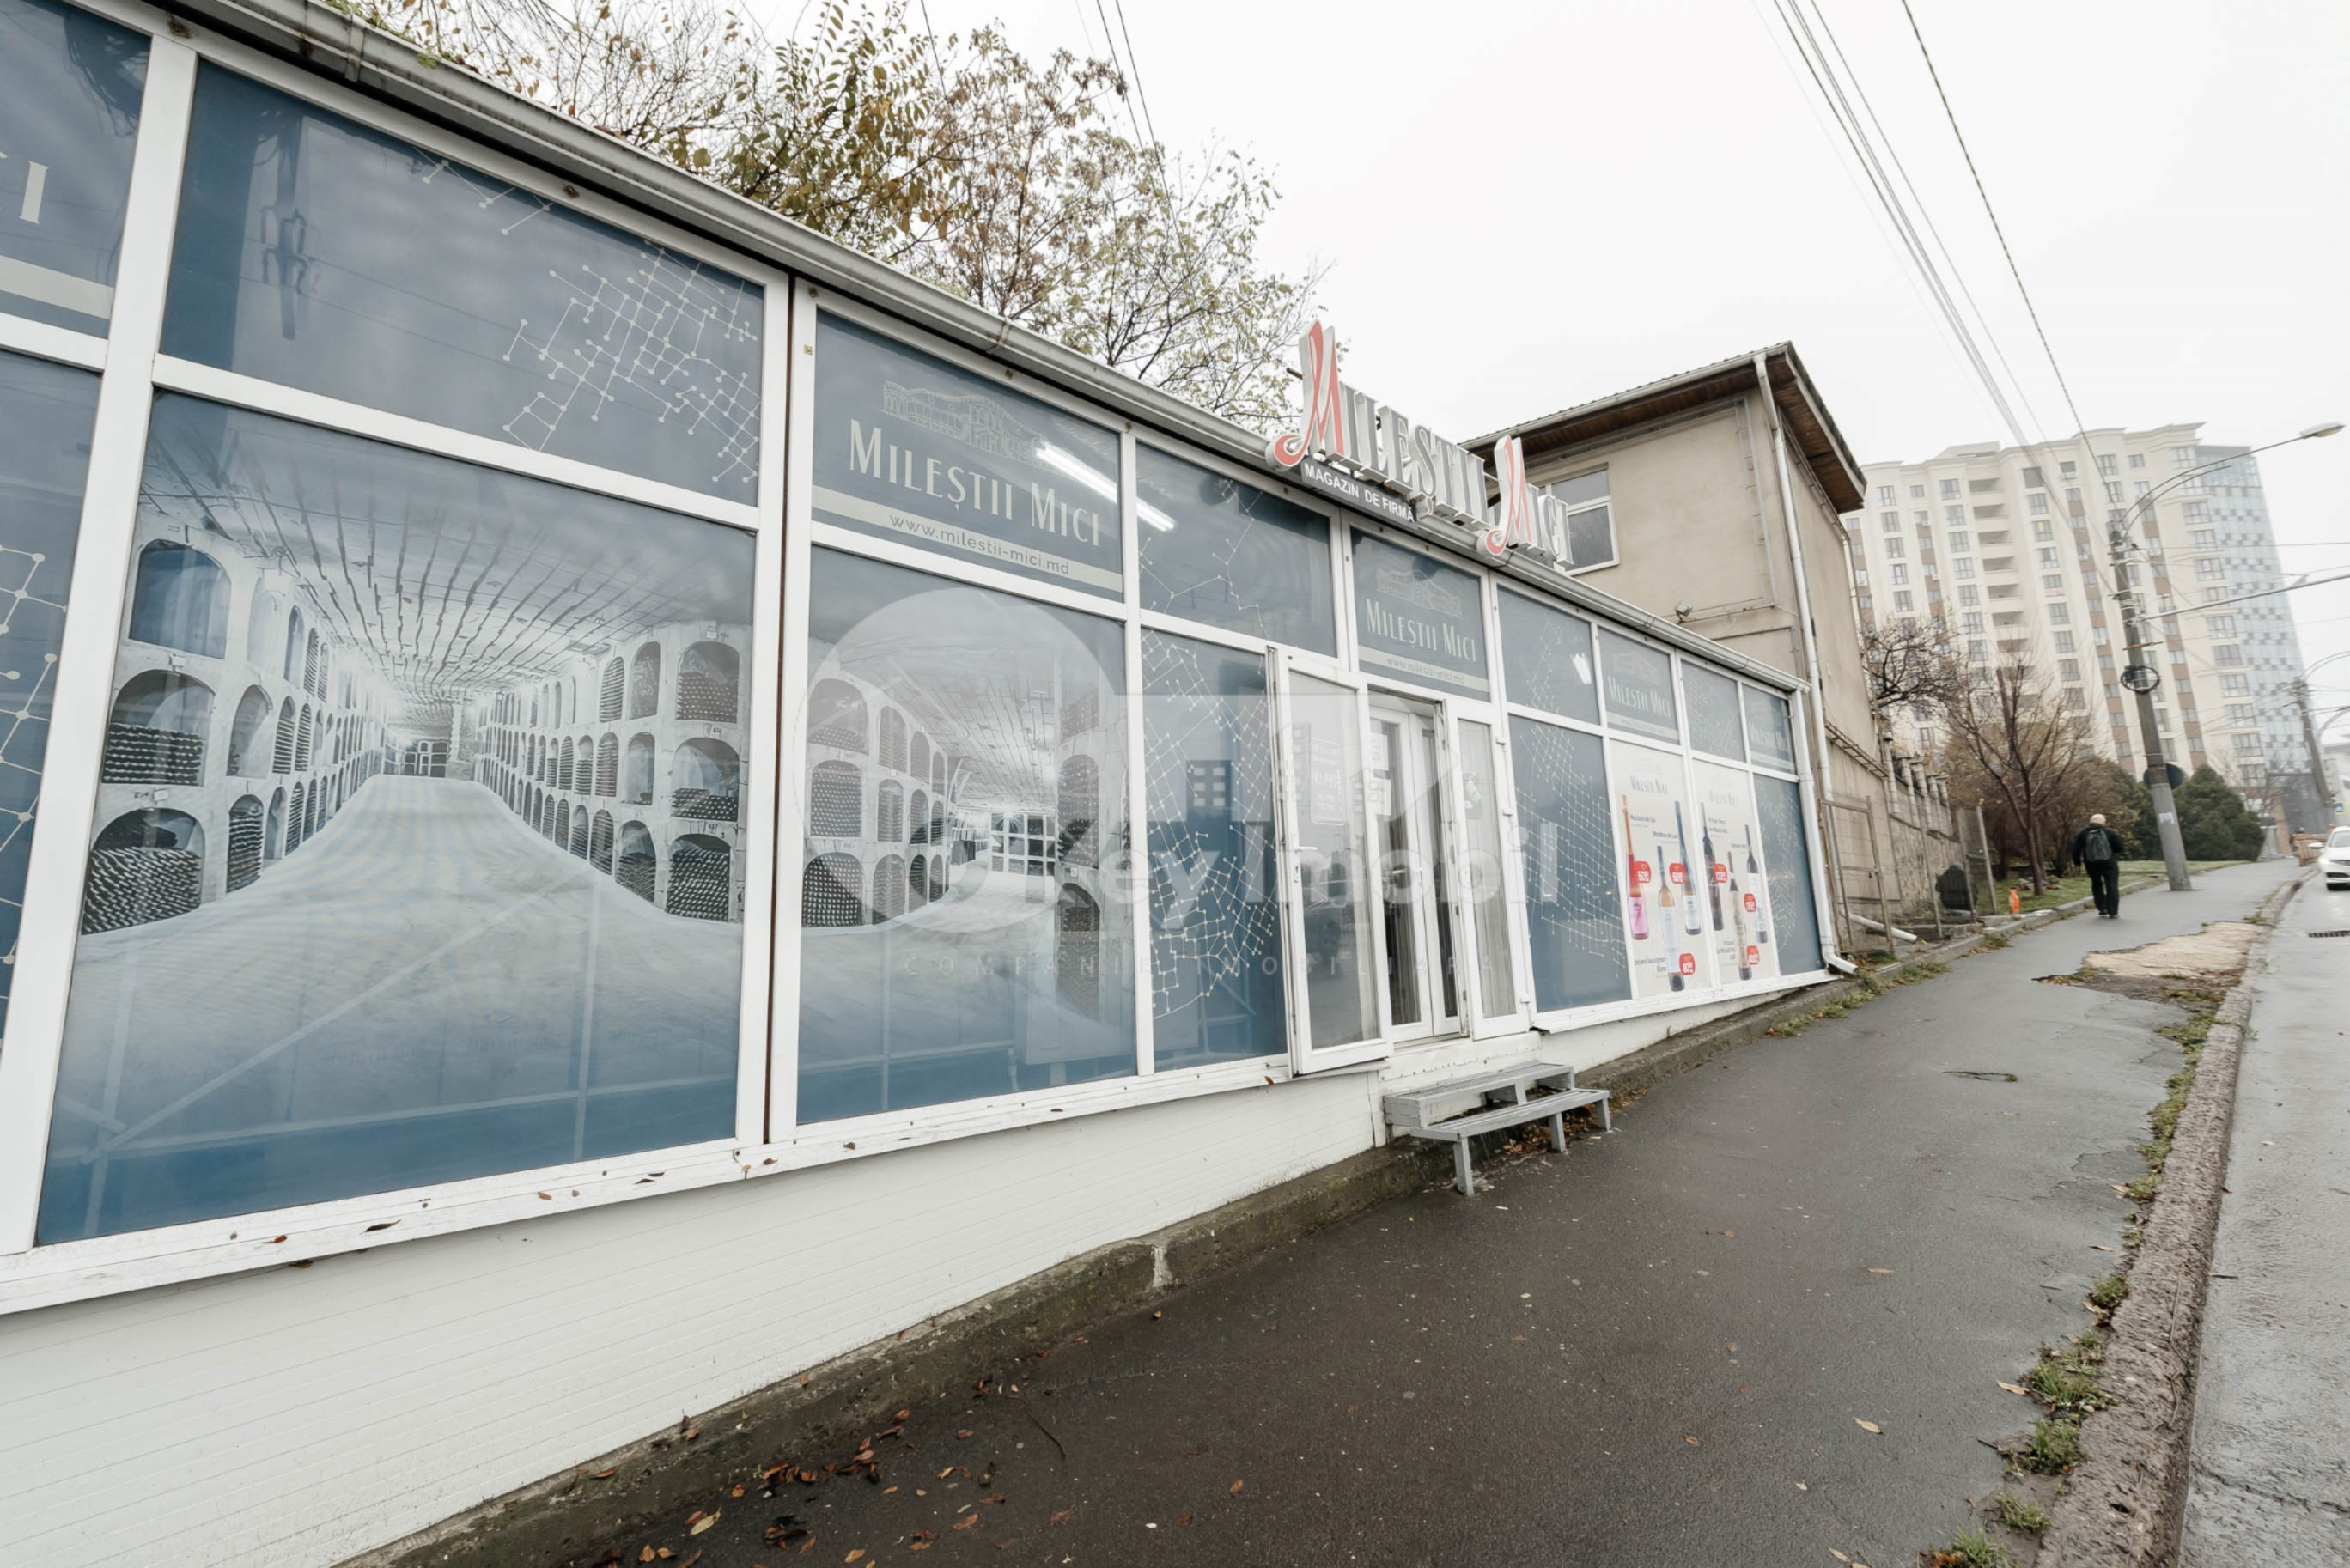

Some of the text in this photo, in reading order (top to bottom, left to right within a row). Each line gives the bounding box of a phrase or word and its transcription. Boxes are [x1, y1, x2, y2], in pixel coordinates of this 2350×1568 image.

[1305, 463, 1360, 498] MAGAZIN
[1364, 489, 1380, 507] DE
[1032, 482, 1100, 546] MICI
[889, 515, 1070, 575] www.milestii-mici.md
[1443, 623, 1477, 662] MICI
